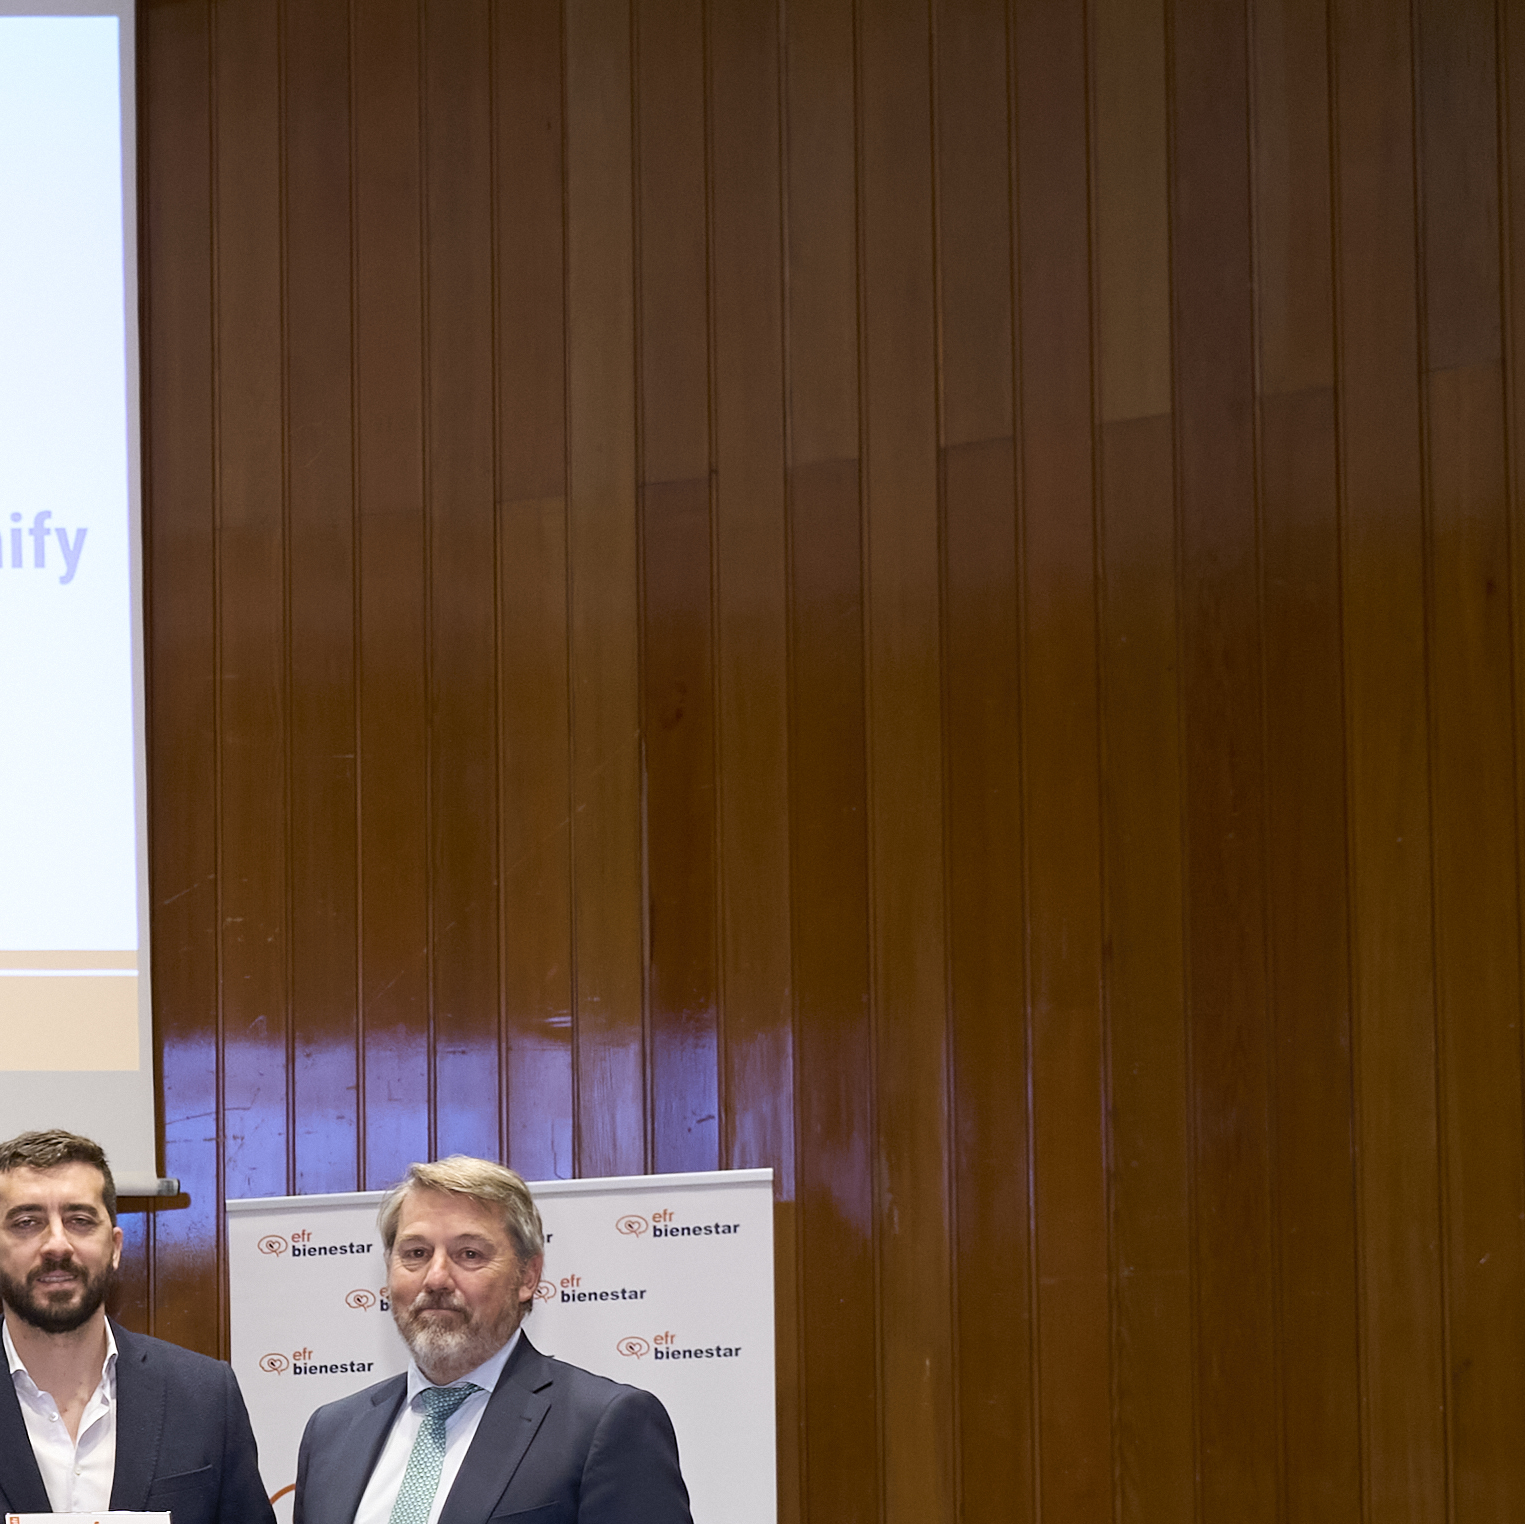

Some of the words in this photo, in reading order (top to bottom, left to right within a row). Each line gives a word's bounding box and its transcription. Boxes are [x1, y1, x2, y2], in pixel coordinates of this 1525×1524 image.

[653, 1208, 674, 1223] efr
[291, 1229, 312, 1243] efr
[652, 1222, 740, 1237] bienestar
[292, 1242, 372, 1257] bienestar
[560, 1274, 581, 1289] efr
[561, 1288, 646, 1303] bienestar
[653, 1330, 675, 1345] efr
[292, 1347, 313, 1361] efr
[654, 1346, 741, 1360] bienestar
[293, 1361, 373, 1375] bienestar
